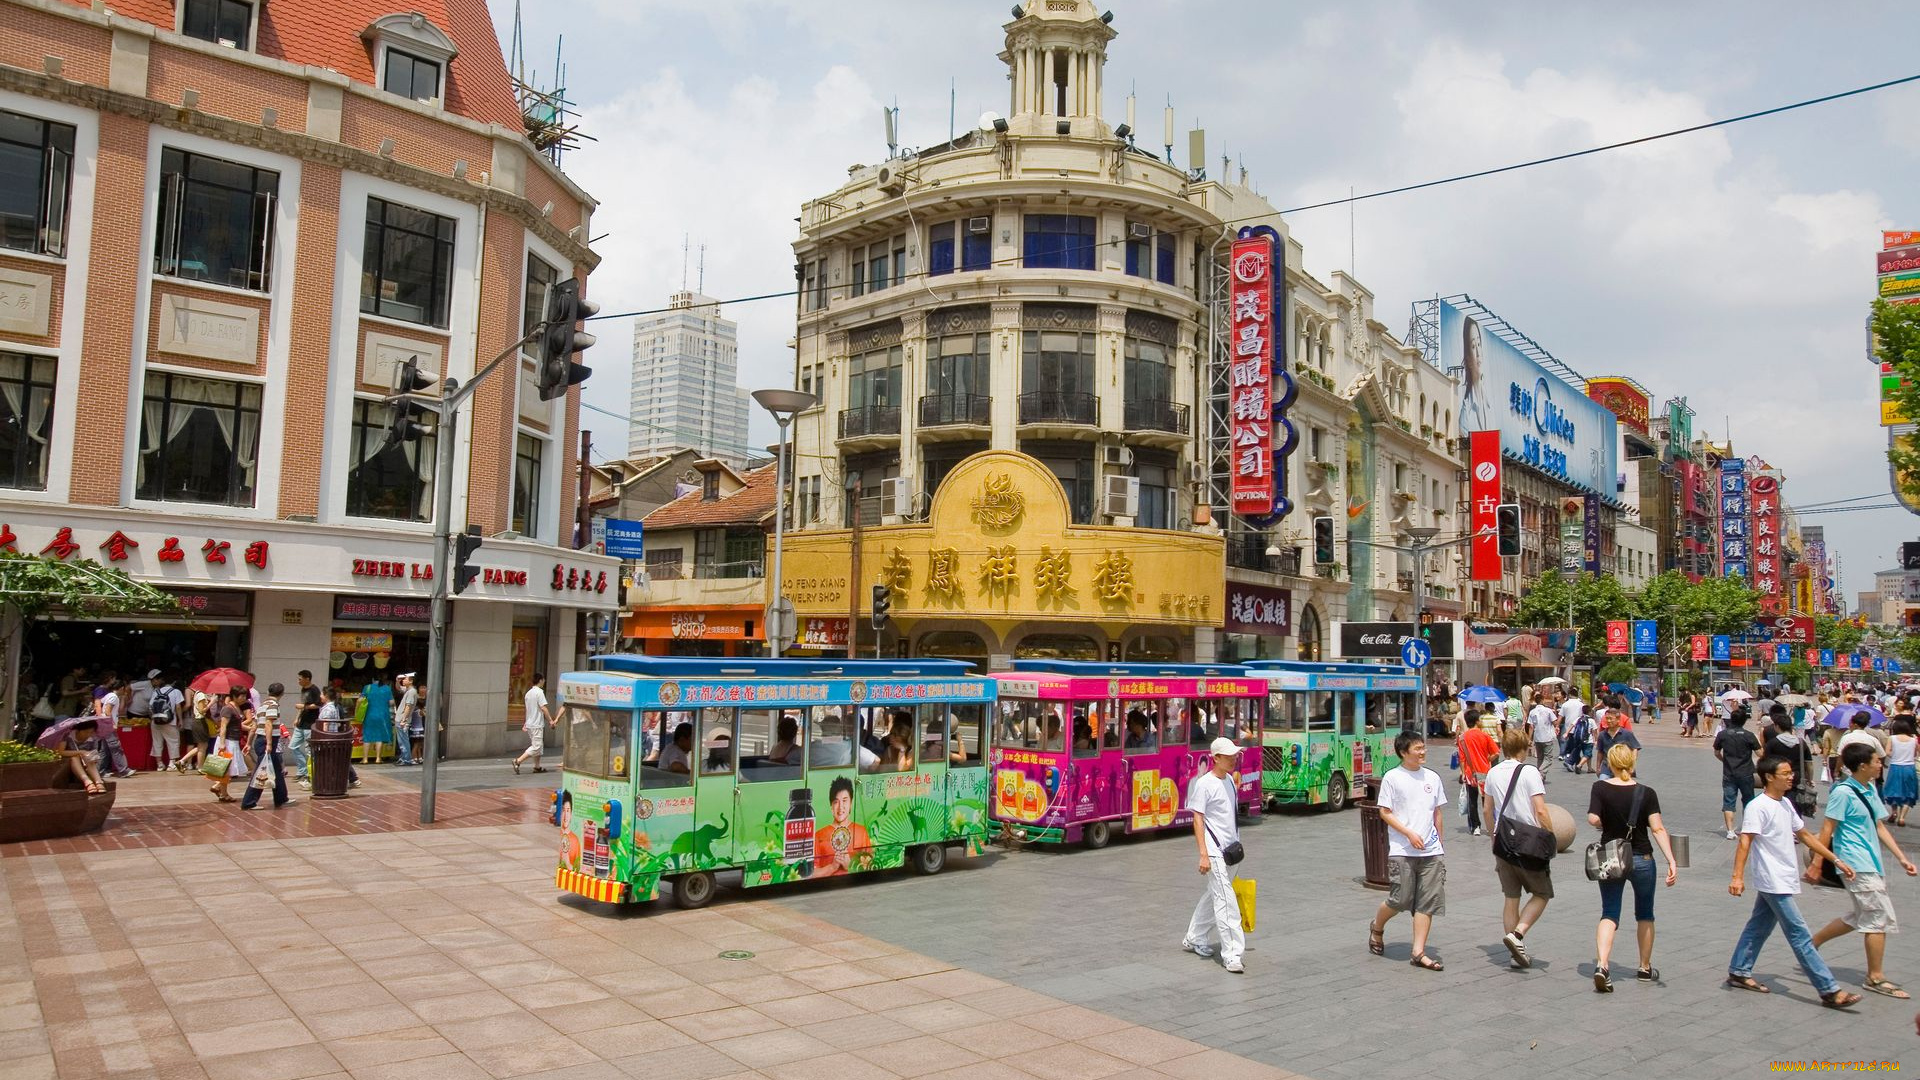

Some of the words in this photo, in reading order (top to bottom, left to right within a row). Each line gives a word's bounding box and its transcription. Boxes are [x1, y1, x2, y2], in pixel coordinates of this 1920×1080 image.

[1234, 290, 1268, 478] 茂昌眼镜公司
[1234, 490, 1270, 500] OPTICAL
[591, 527, 605, 535] 158
[352, 559, 405, 579] ZHEN
[410, 563, 434, 580] LA
[483, 568, 528, 586] FANG
[796, 579, 817, 589] FENG
[820, 577, 846, 588] XIANG
[818, 592, 841, 603] SHOP
[672, 612, 699, 626] EASY
[681, 622, 707, 637] SHOP
